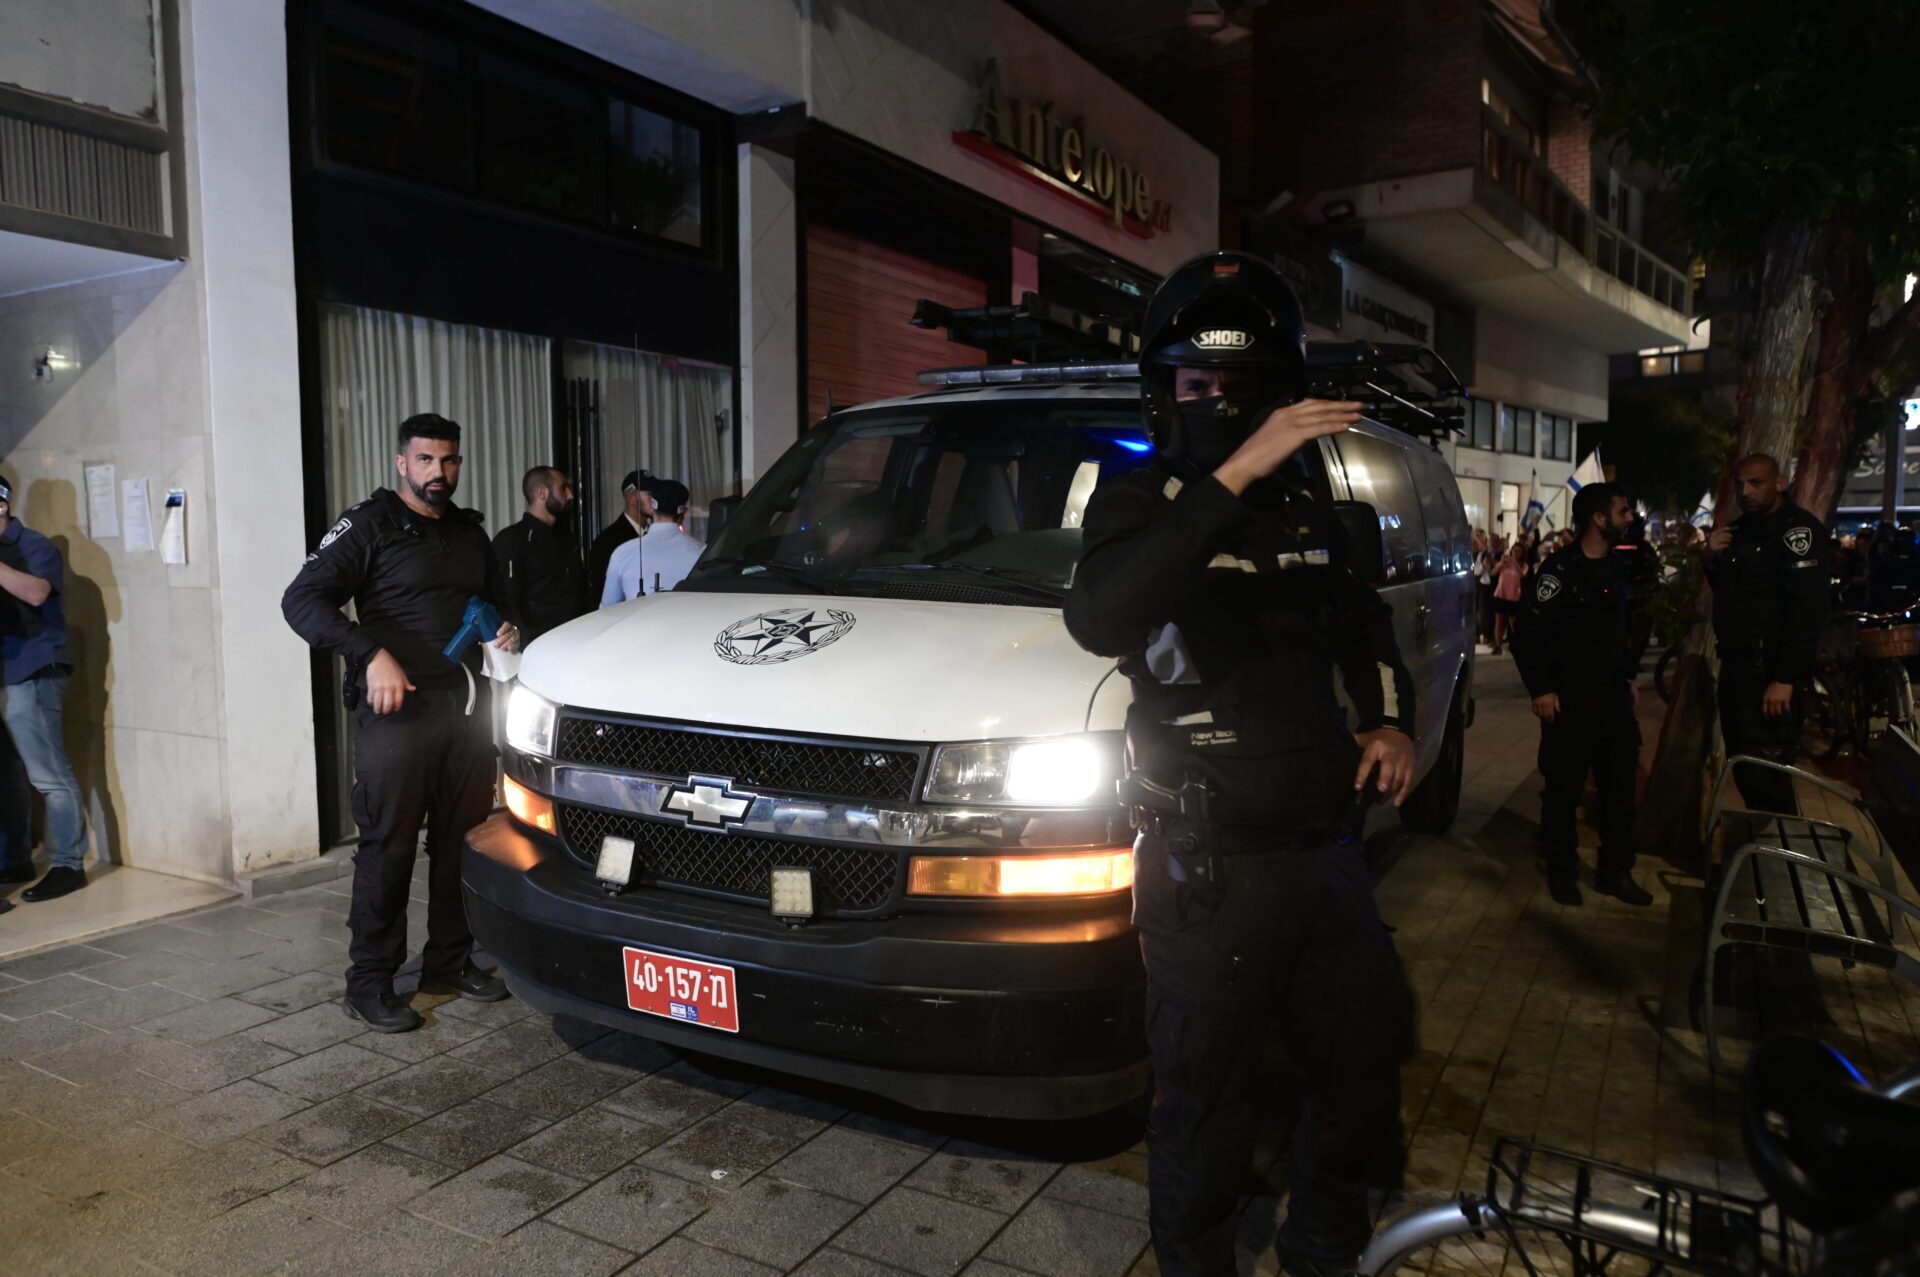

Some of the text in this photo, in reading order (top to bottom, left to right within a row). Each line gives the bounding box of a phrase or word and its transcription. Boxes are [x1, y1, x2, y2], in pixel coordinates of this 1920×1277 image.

[970, 57, 1149, 230] Antelope
[1200, 330, 1247, 346] SHOEI
[1191, 731, 1213, 740] New
